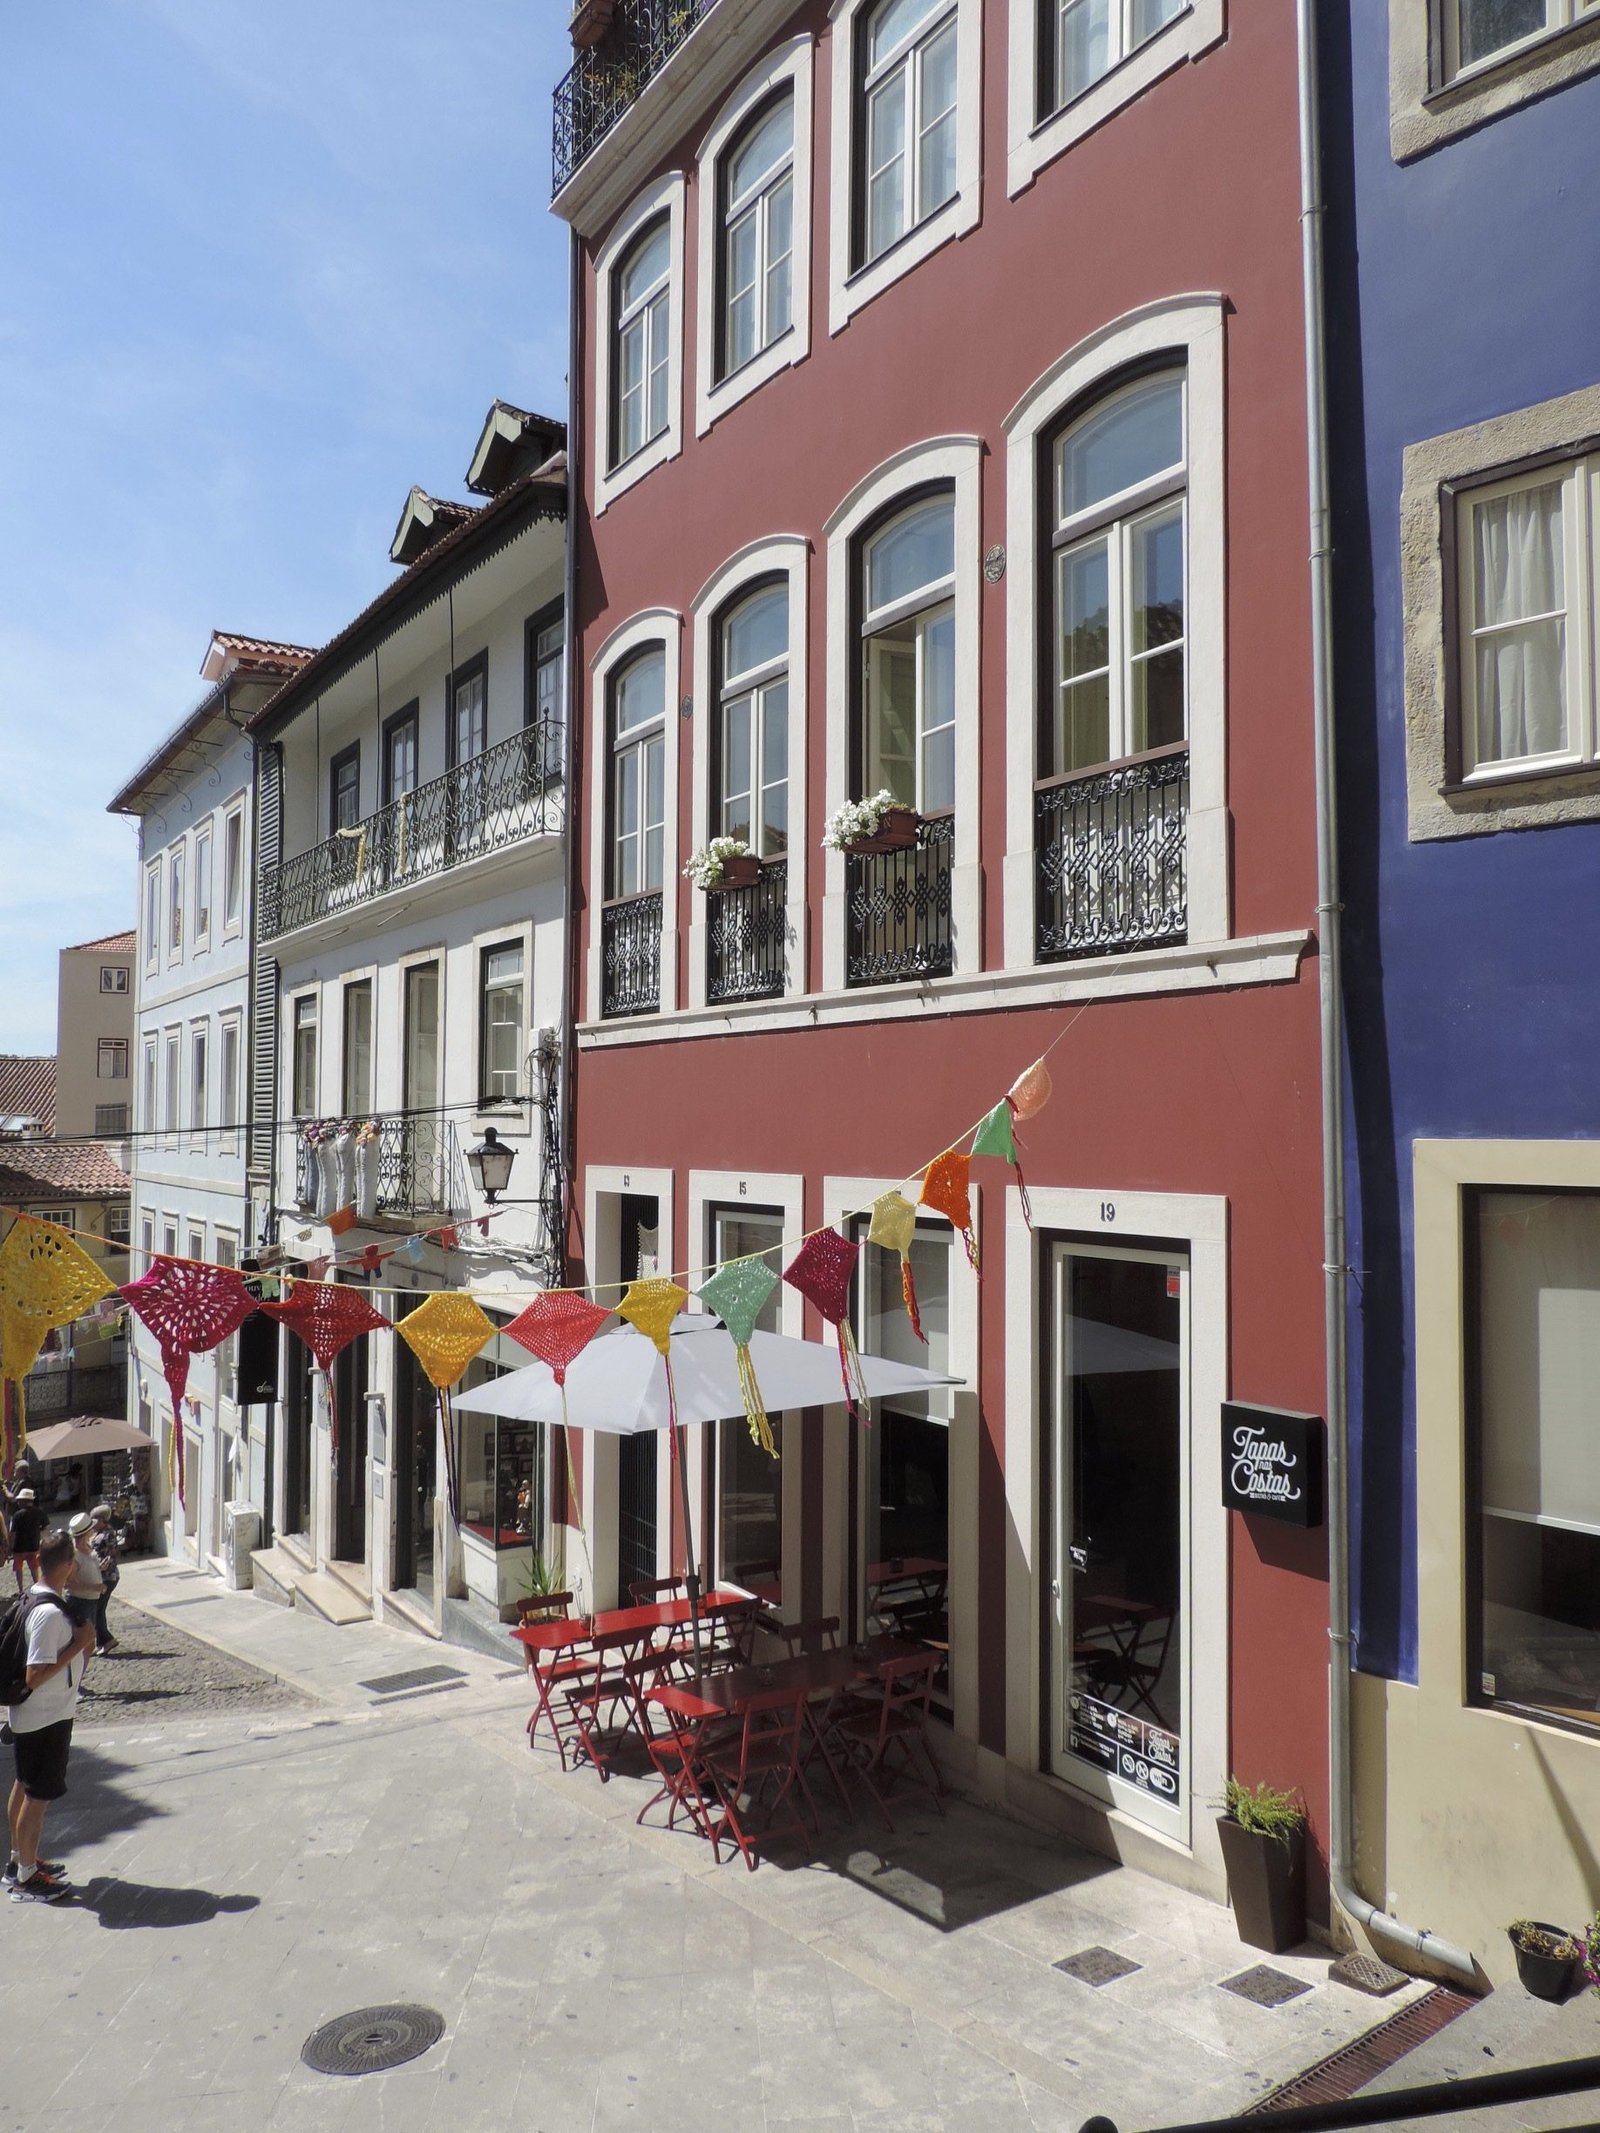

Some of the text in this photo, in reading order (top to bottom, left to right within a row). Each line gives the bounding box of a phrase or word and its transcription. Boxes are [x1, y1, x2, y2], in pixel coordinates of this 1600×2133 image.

[739, 1180, 747, 1195] 15
[1100, 1202, 1115, 1222] 19
[1231, 1426, 1297, 1471] Tapas
[1231, 1459, 1301, 1500] Costas
